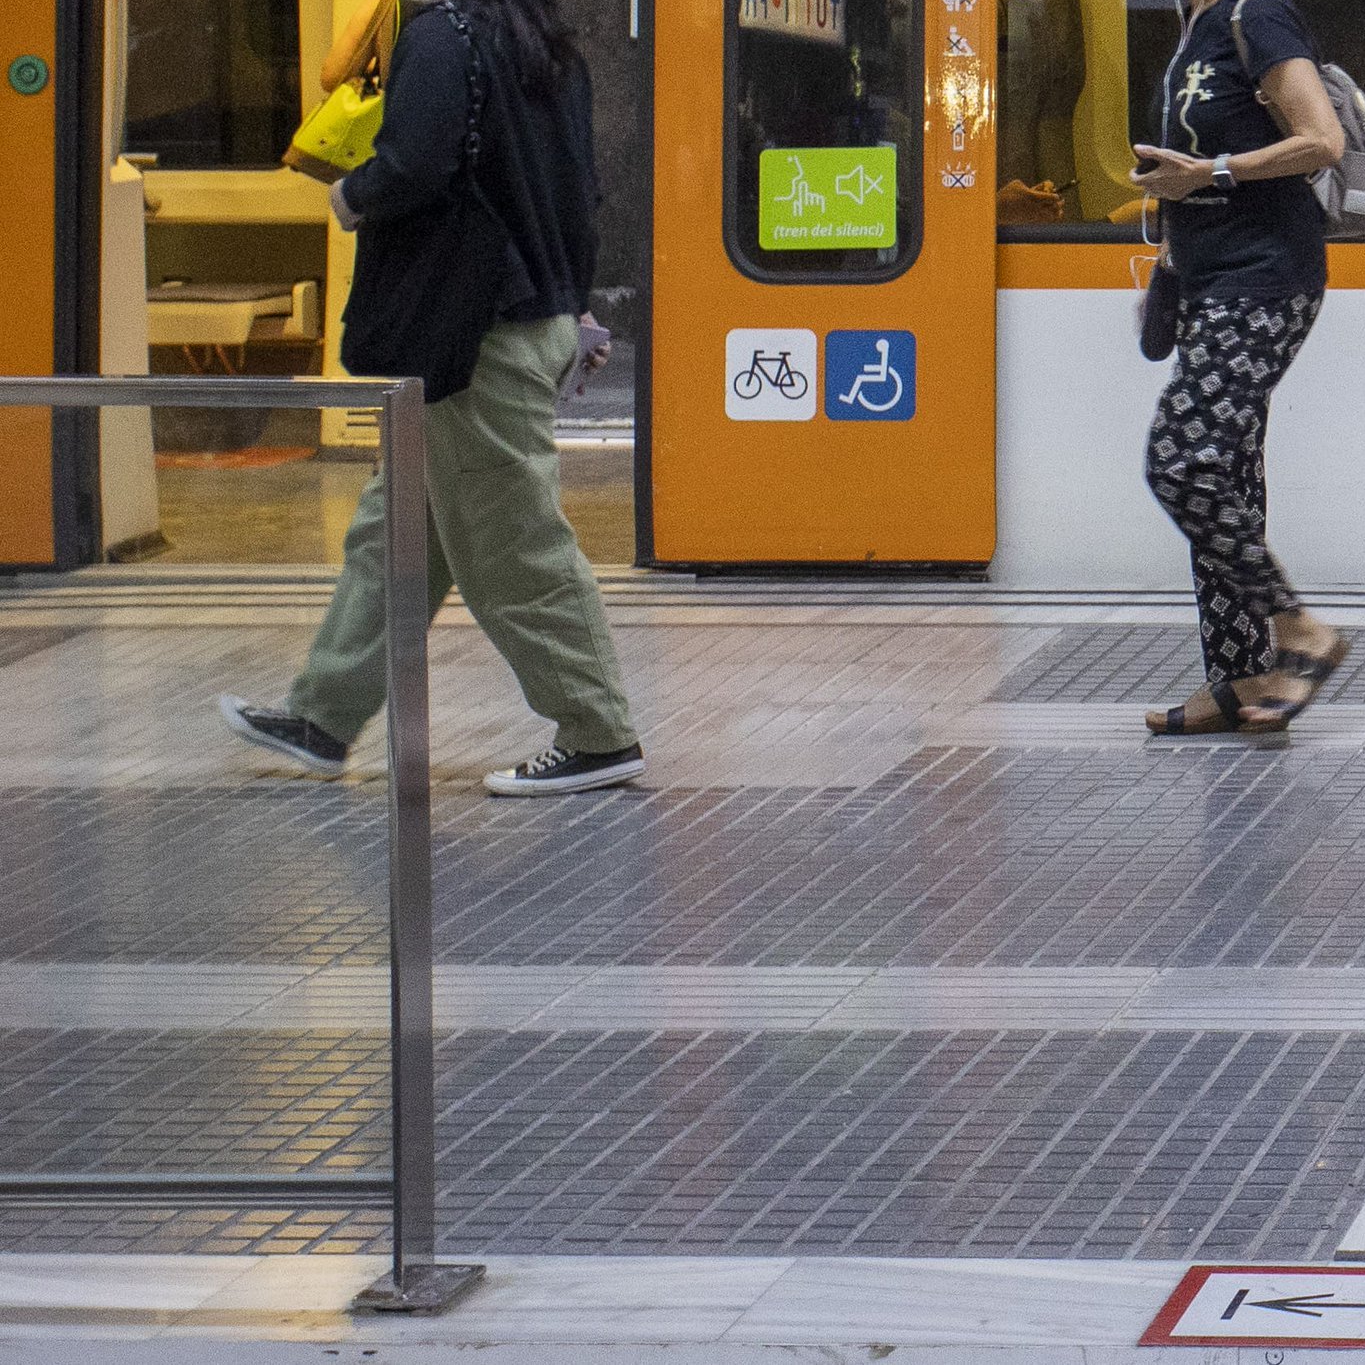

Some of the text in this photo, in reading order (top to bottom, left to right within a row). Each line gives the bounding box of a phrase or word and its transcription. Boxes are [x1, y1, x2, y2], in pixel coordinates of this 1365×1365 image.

[775, 223, 884, 239] (tren del silenci)
